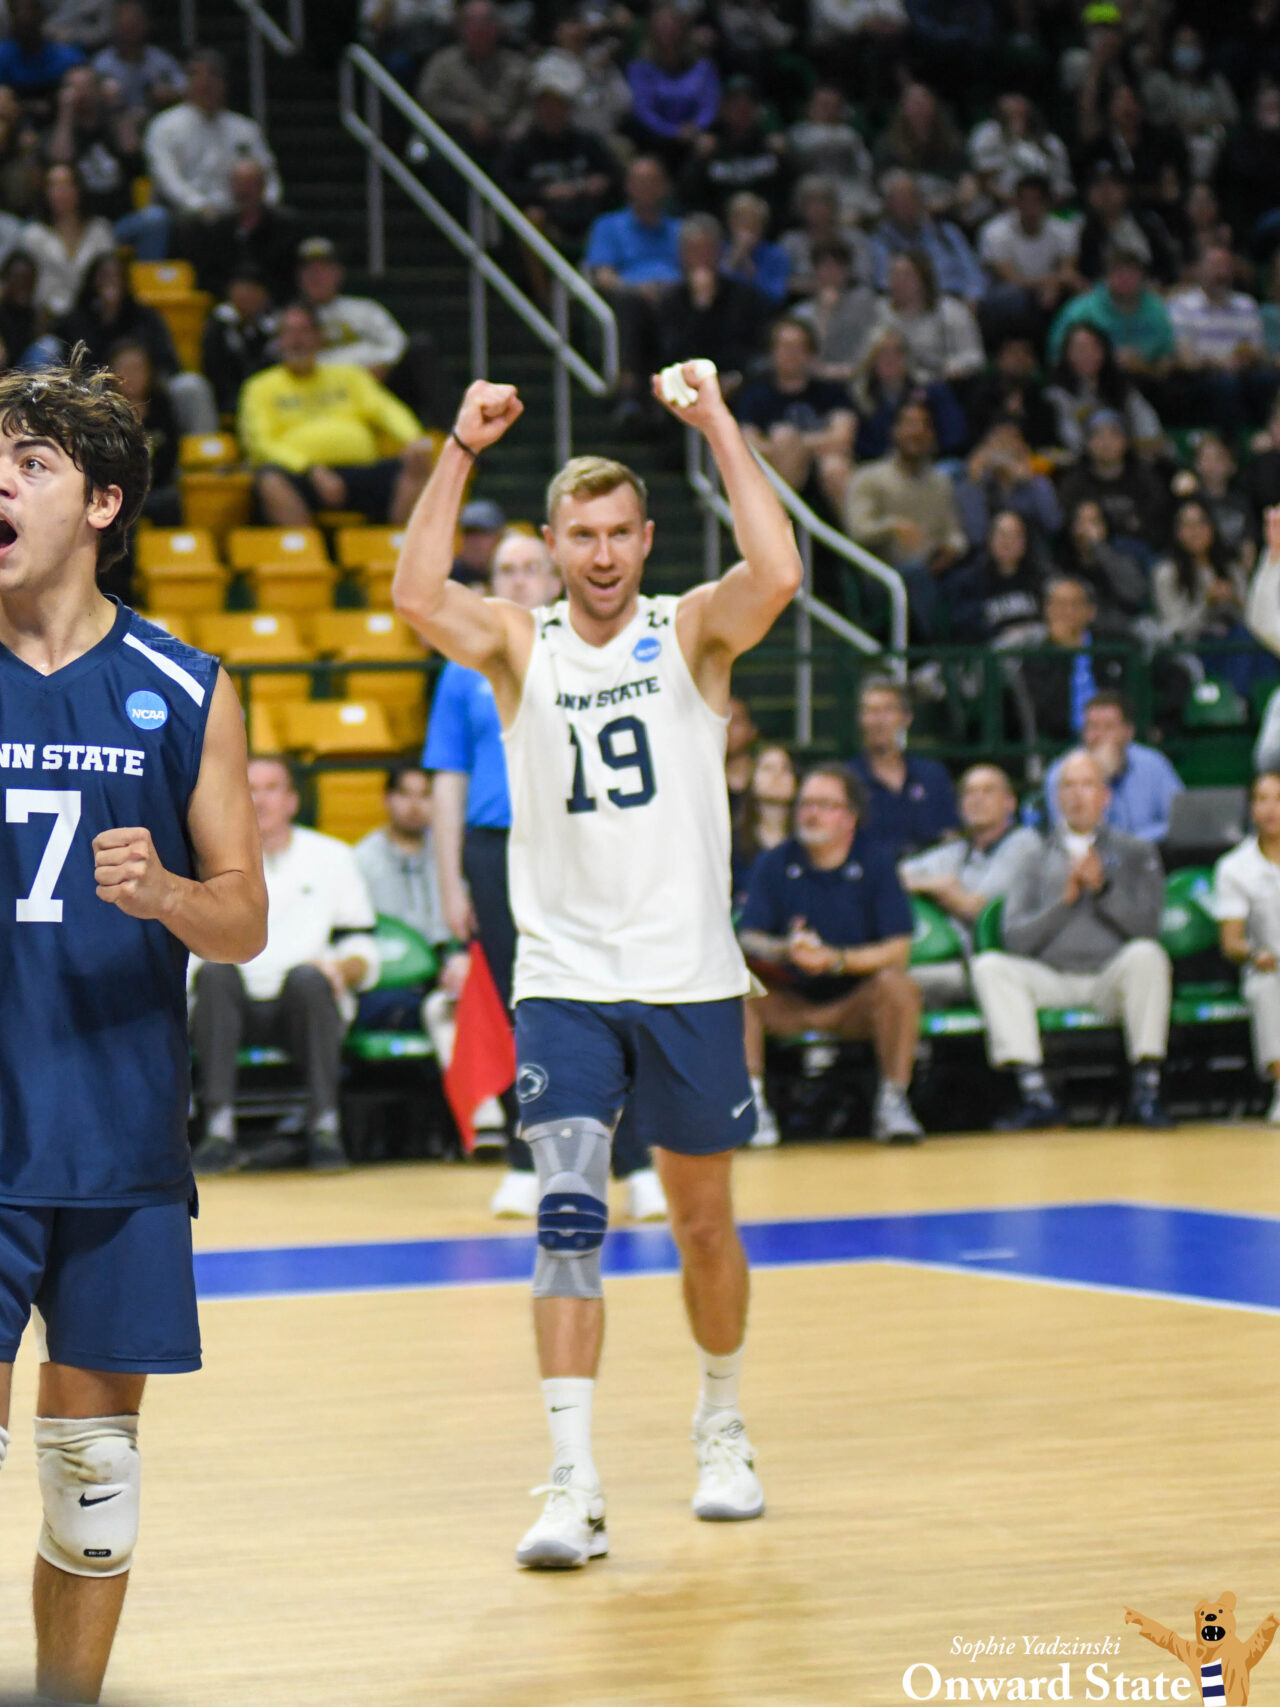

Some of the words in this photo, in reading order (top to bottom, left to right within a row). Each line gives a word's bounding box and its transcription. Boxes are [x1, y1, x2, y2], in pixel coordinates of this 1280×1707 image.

[596, 676, 660, 708] STATE
[131, 708, 166, 721] NCAA
[42, 744, 145, 776] STATE
[565, 714, 657, 814] 19
[5, 788, 82, 922] 7
